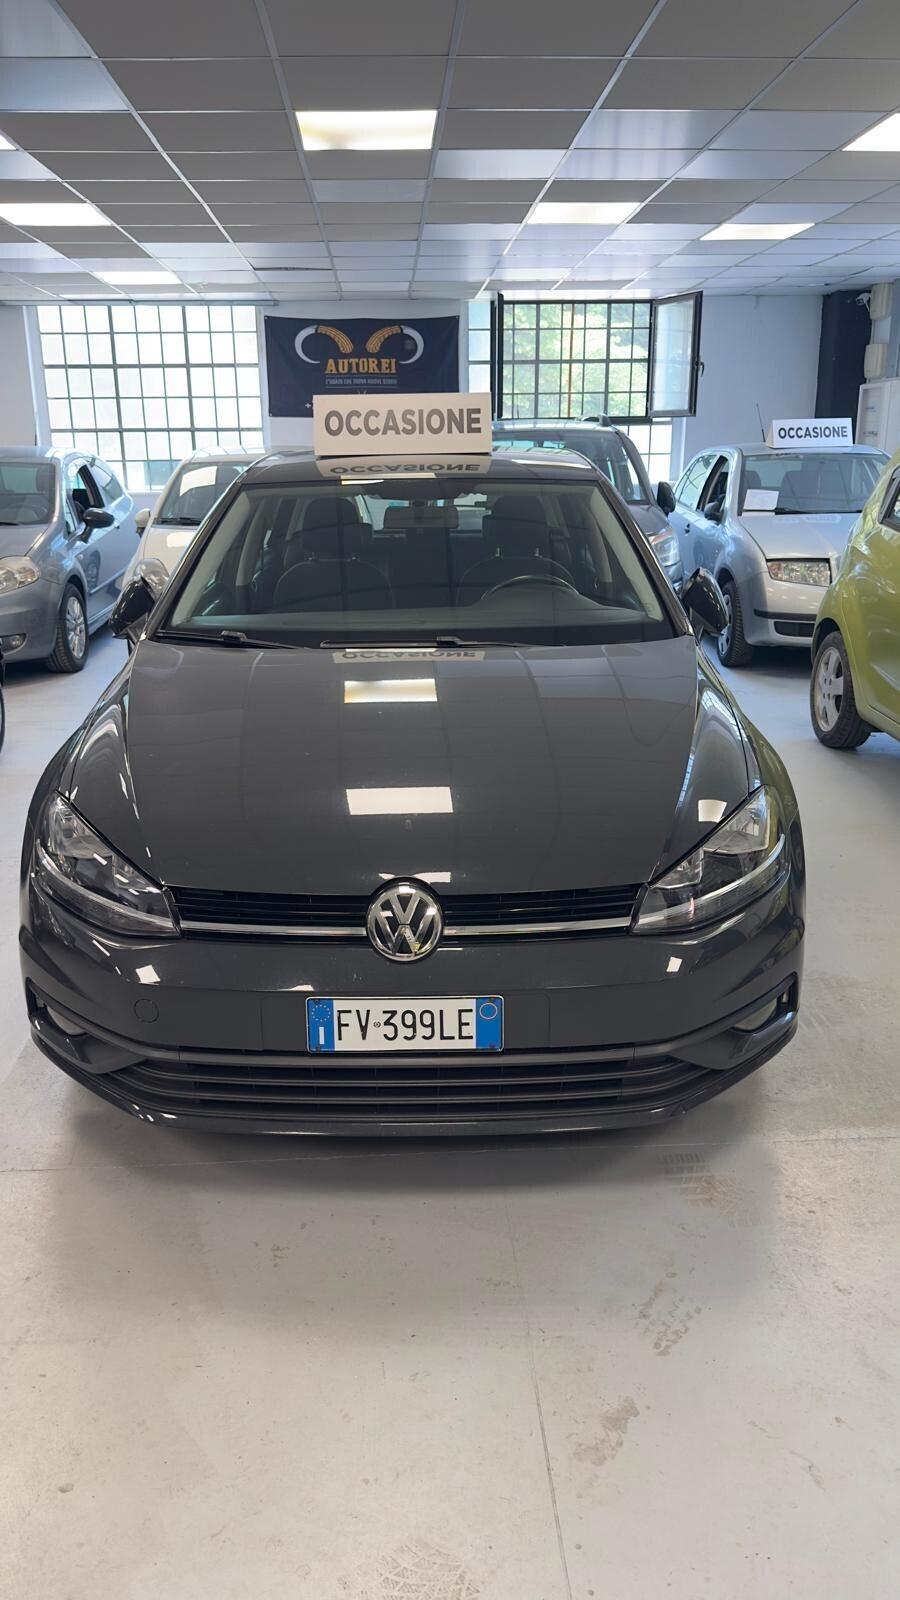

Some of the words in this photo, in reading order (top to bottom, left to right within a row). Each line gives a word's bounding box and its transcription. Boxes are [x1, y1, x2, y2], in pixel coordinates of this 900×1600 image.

[325, 358, 396, 373] AUTOREI
[324, 408, 482, 436] OCCASIONE
[778, 426, 848, 440] OCCASIONE
